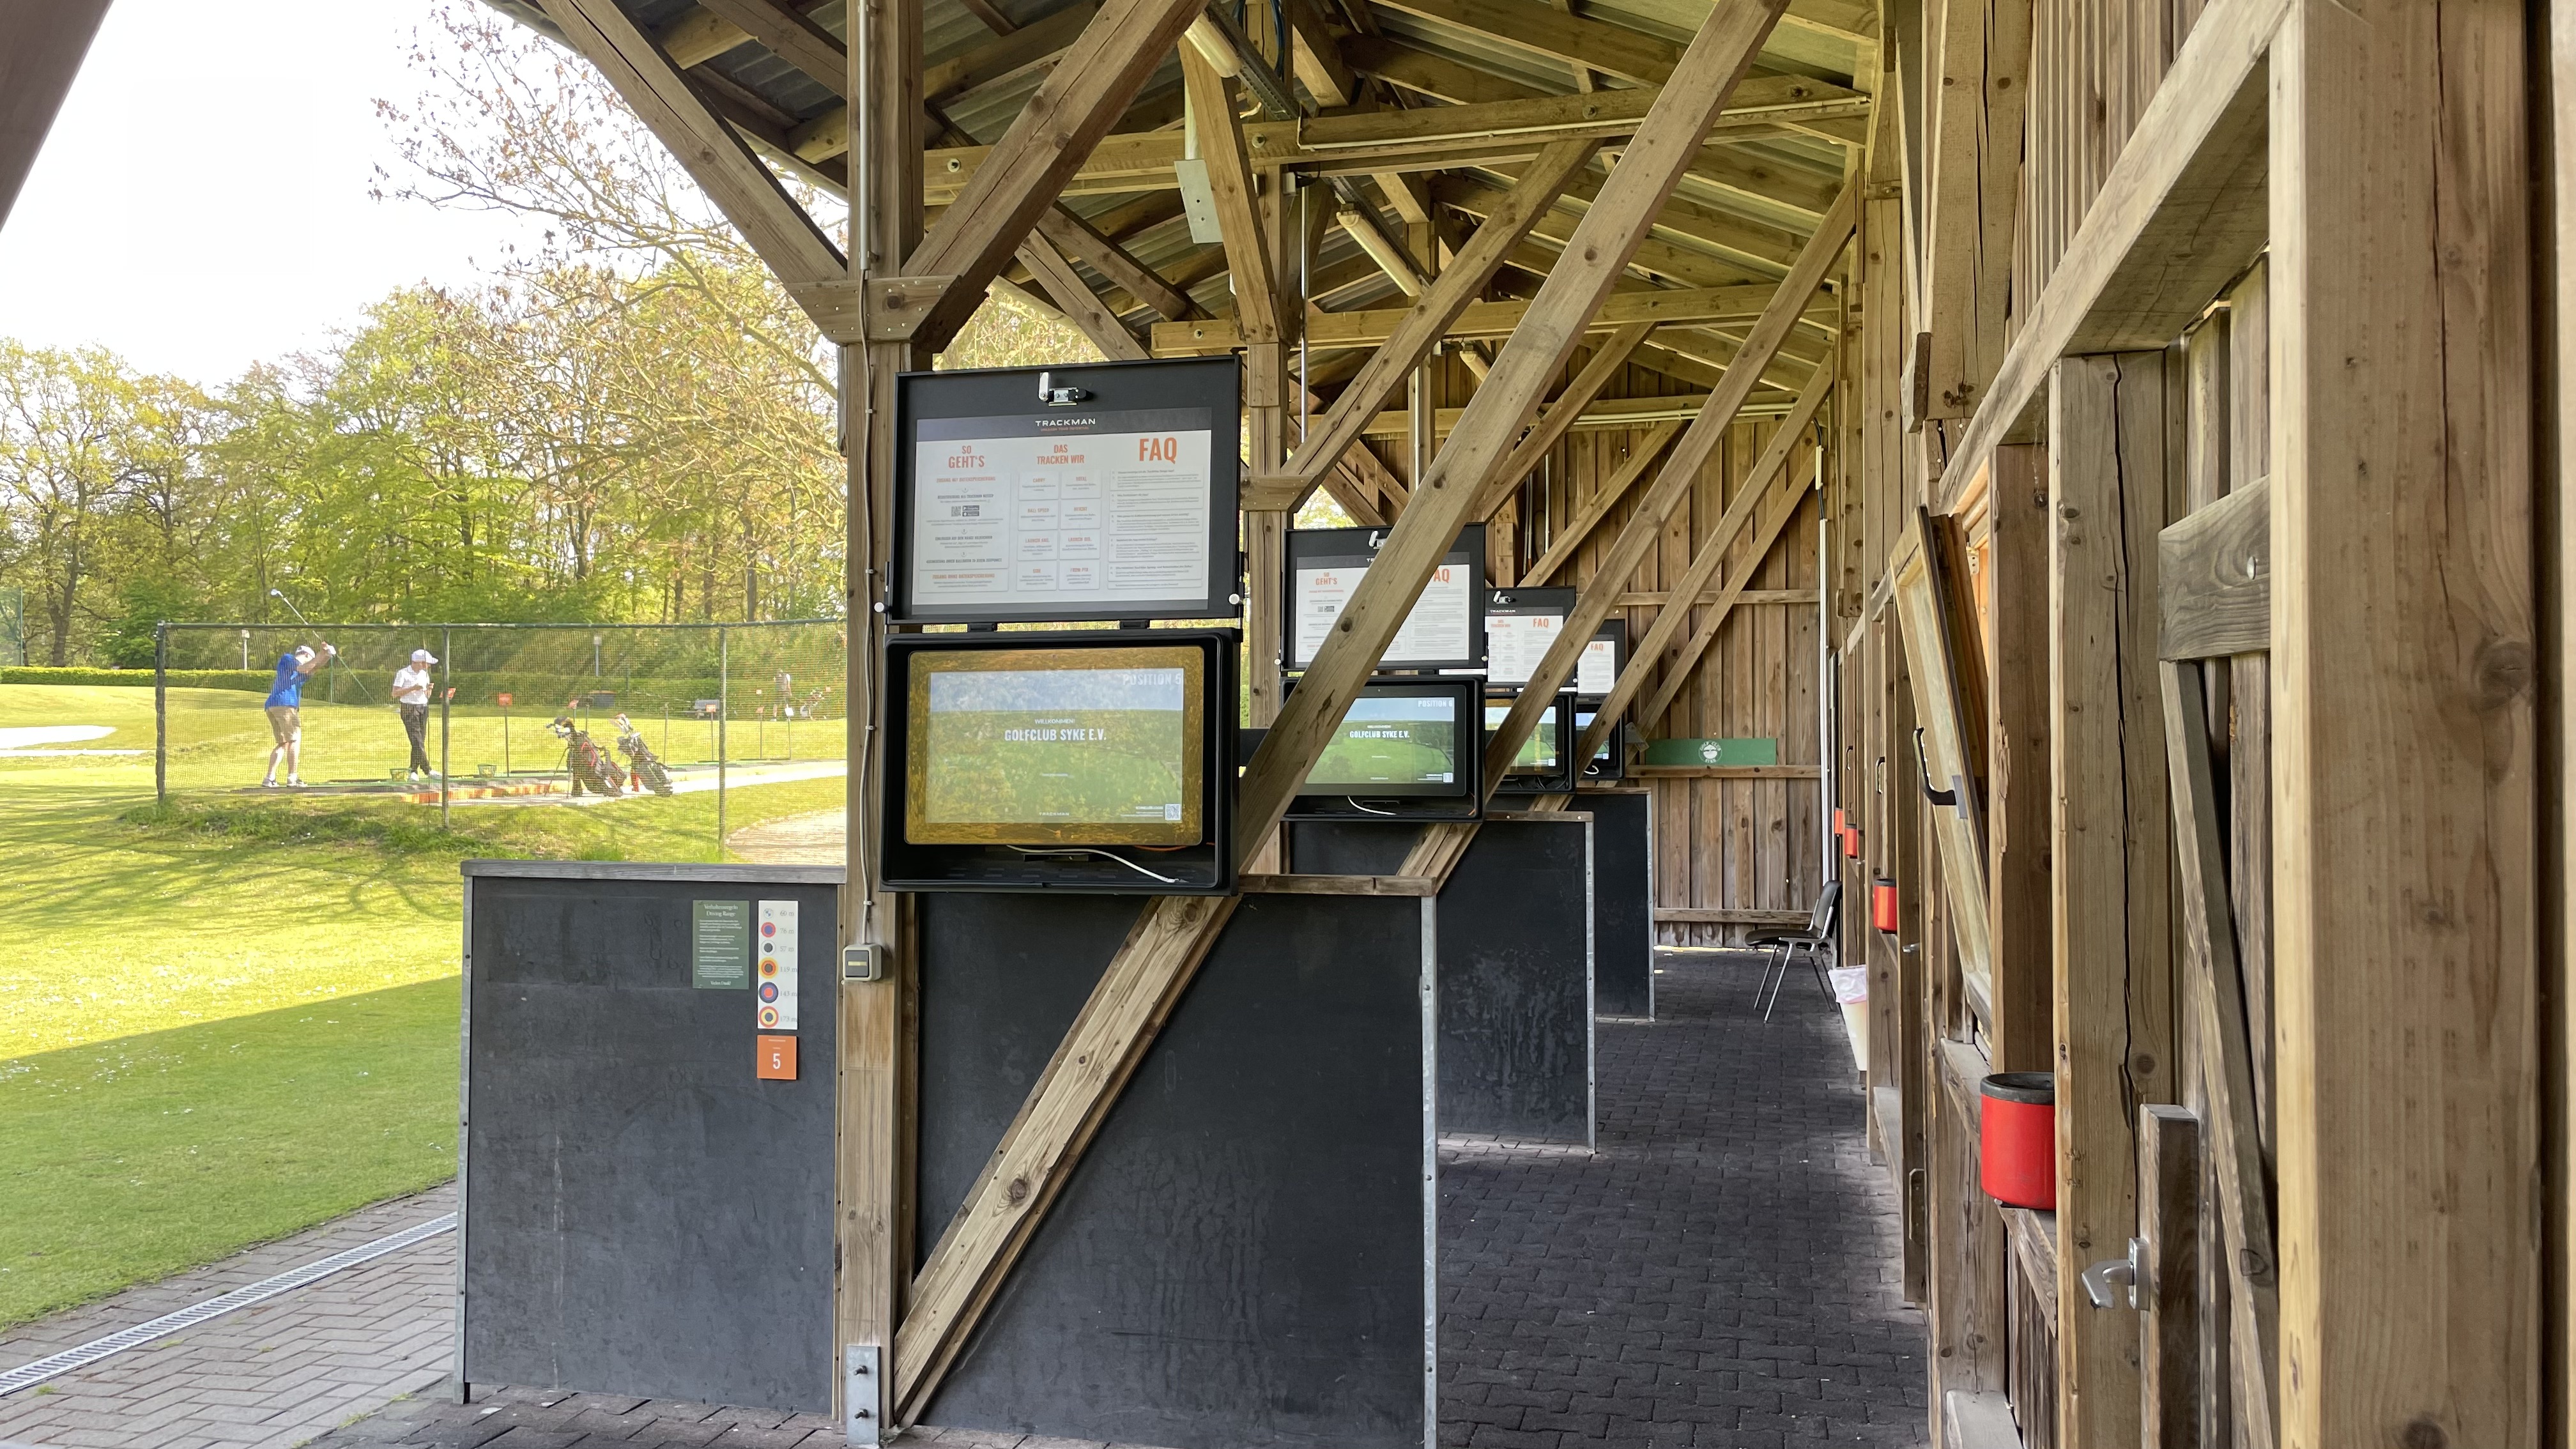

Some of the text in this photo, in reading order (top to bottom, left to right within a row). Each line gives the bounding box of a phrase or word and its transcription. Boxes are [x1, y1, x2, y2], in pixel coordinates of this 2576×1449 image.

[1035, 418, 1096, 427] TRACKMAN
[962, 445, 972, 454] SO
[1054, 444, 1068, 454] DAS
[1139, 437, 1177, 464] FAQ
[1036, 454, 1085, 464] TRACKEN WIR
[1433, 568, 1450, 583] AQ
[1533, 618, 1549, 629] FAQ
[1591, 643, 1604, 652] FAQ
[1123, 673, 1181, 686] POSITION 5
[1004, 728, 1107, 741] GOLFCLUB SYKE E.V.
[1349, 730, 1381, 739] GOLFCLUB
[772, 1053, 781, 1070] 5
